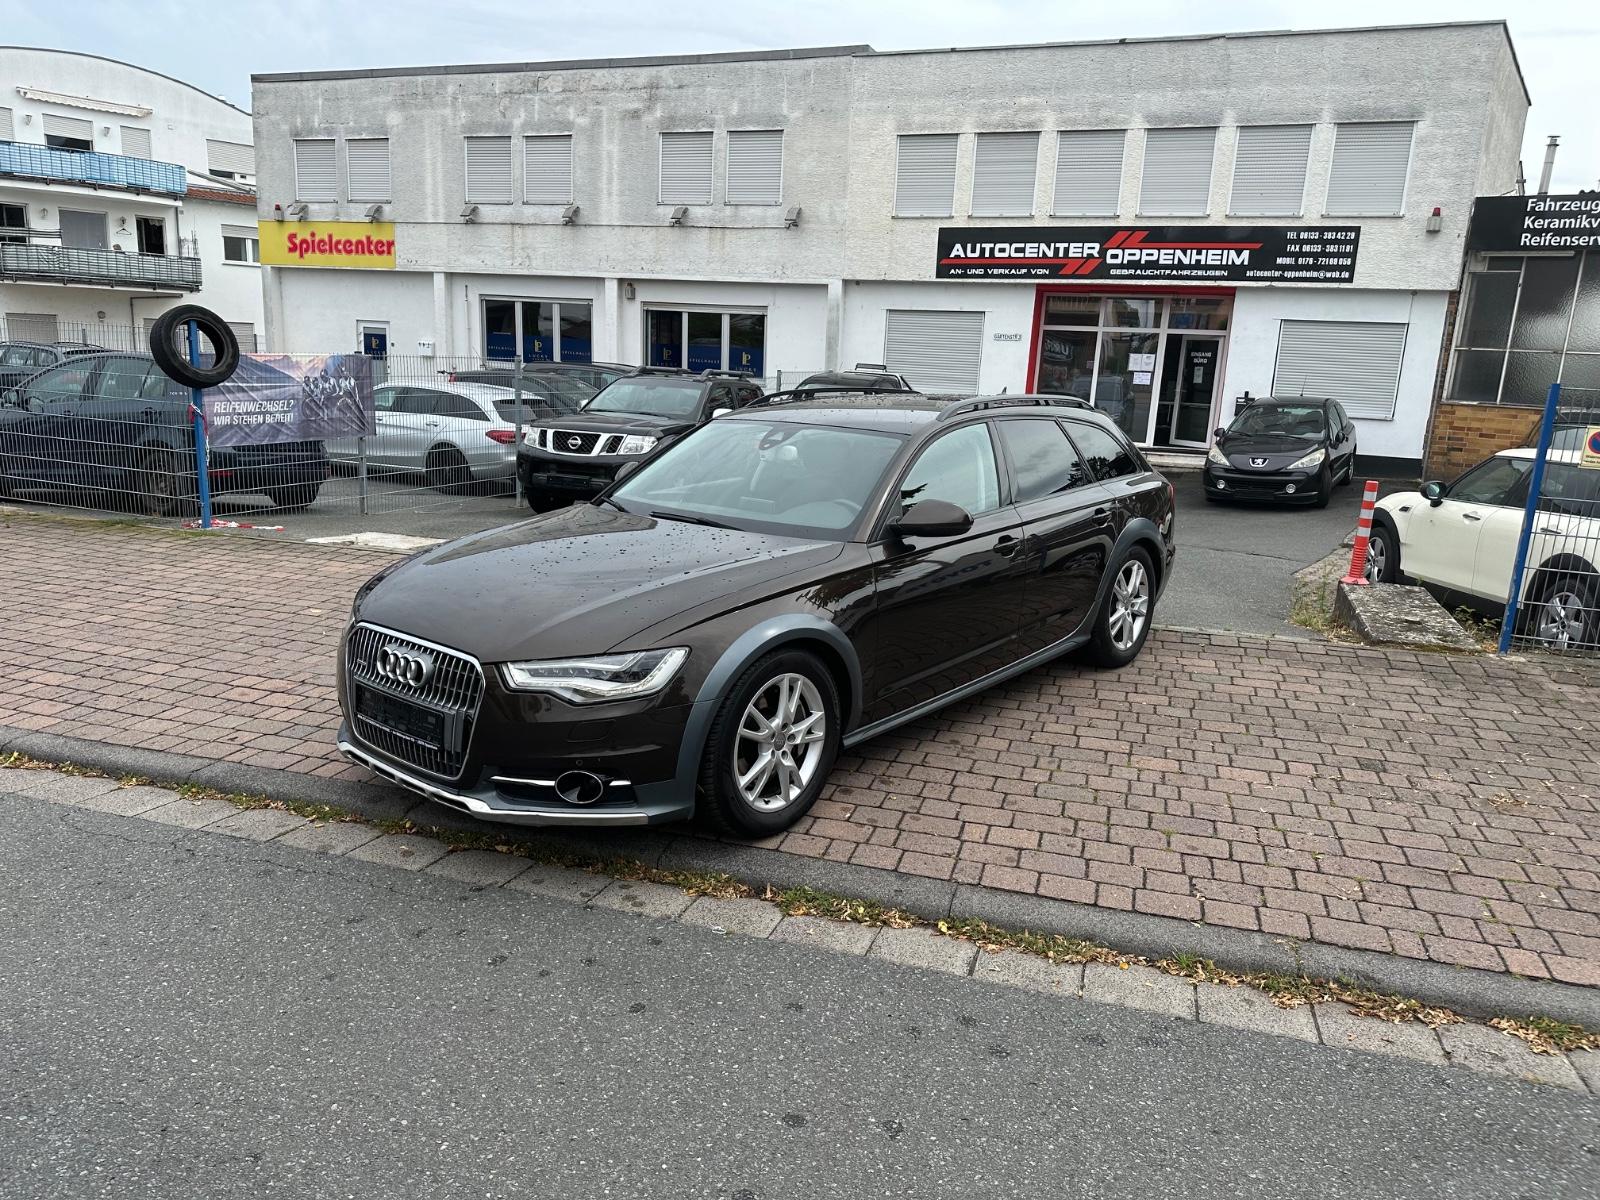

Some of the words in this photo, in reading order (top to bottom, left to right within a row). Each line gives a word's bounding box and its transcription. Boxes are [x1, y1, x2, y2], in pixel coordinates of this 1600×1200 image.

[1526, 198, 1600, 214] Fahrzeug
[287, 231, 396, 260] Spielcenter
[949, 242, 1101, 259] AUTOCENTER
[1105, 249, 1250, 266] OPPENHEIM
[1276, 257, 1296, 265] MOBIL
[214, 399, 294, 413] REIFENWECHSEL?
[214, 415, 231, 425] WIR
[232, 414, 263, 425] STEHEN
